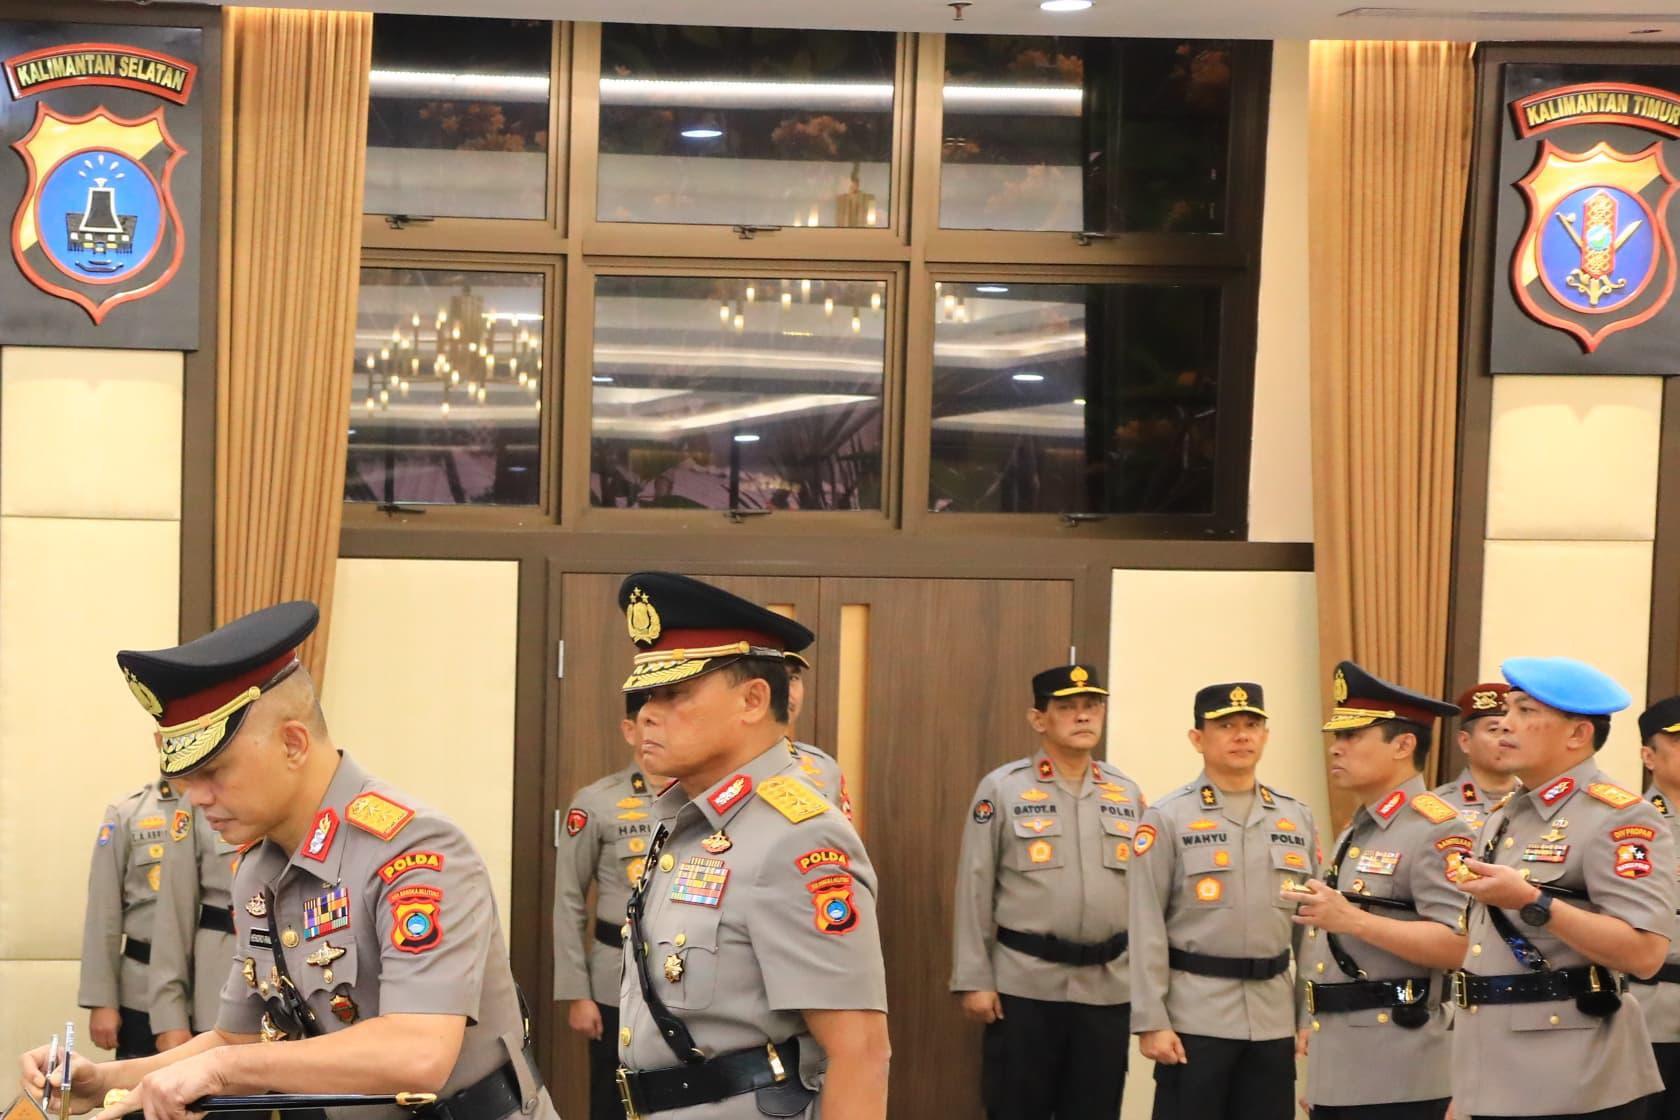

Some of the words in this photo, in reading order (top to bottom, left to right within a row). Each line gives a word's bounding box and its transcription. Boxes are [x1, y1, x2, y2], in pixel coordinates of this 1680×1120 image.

[17, 54, 115, 87] KALIMANTAN
[119, 56, 186, 91] SELATAN
[1526, 93, 1629, 127] KALIMANTAN
[1633, 95, 1680, 126] TIMUR
[619, 824, 651, 835] HARI
[1182, 833, 1227, 846] WAHYU
[384, 854, 438, 879] POLDA
[800, 851, 846, 869] POLDA
